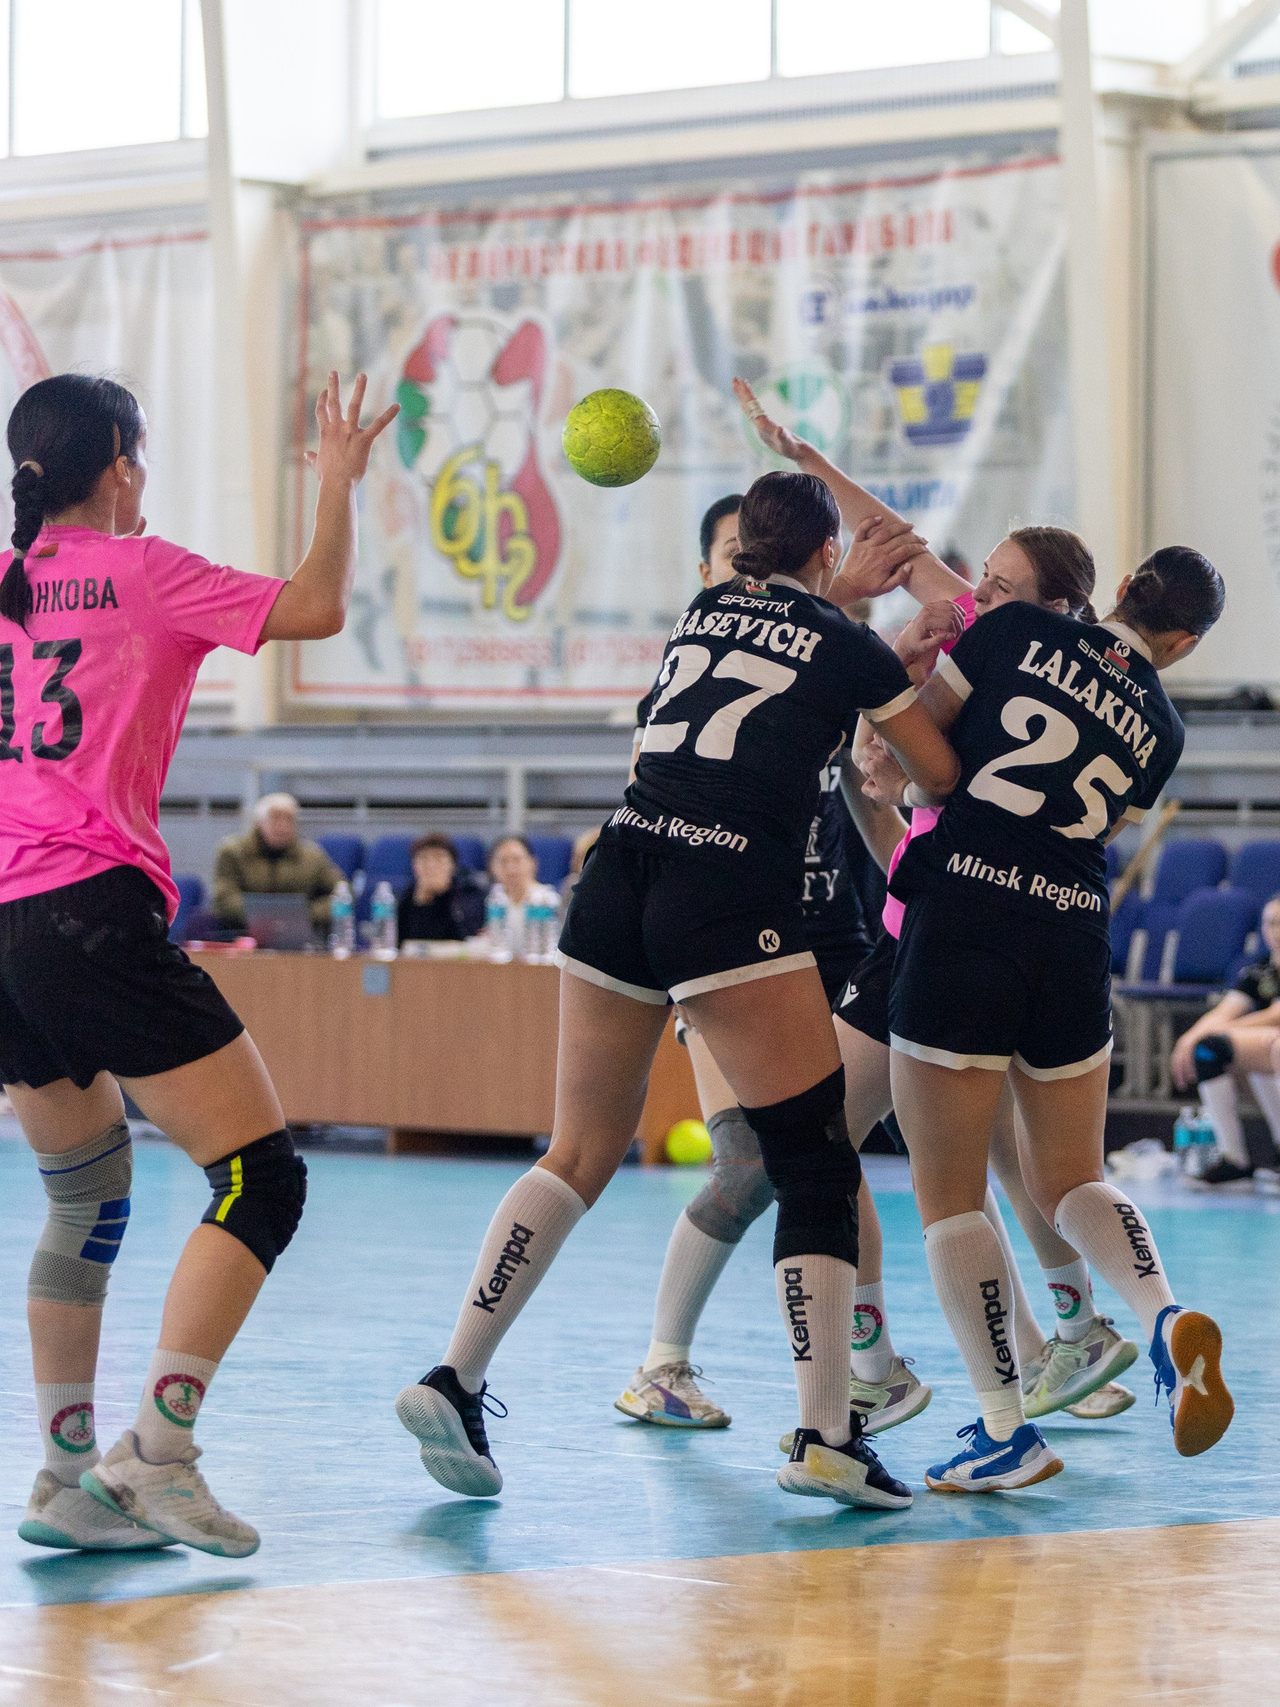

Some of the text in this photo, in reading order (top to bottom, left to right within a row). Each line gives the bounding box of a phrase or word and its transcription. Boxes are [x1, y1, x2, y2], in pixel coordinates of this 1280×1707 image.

[717, 594, 796, 618] SPORTIX
[640, 644, 798, 761] 27
[1018, 640, 1157, 769] LALAKINA
[1077, 638, 1148, 708] SPORTIX
[967, 696, 1133, 840] 25
[608, 805, 748, 852] Minsk Region
[947, 852, 1101, 912] Minsk Region
[473, 1222, 535, 1315] Kempa
[1112, 1203, 1160, 1279] Kempa
[784, 1267, 812, 1362] Kempa
[979, 1278, 1019, 1386] Kempa
